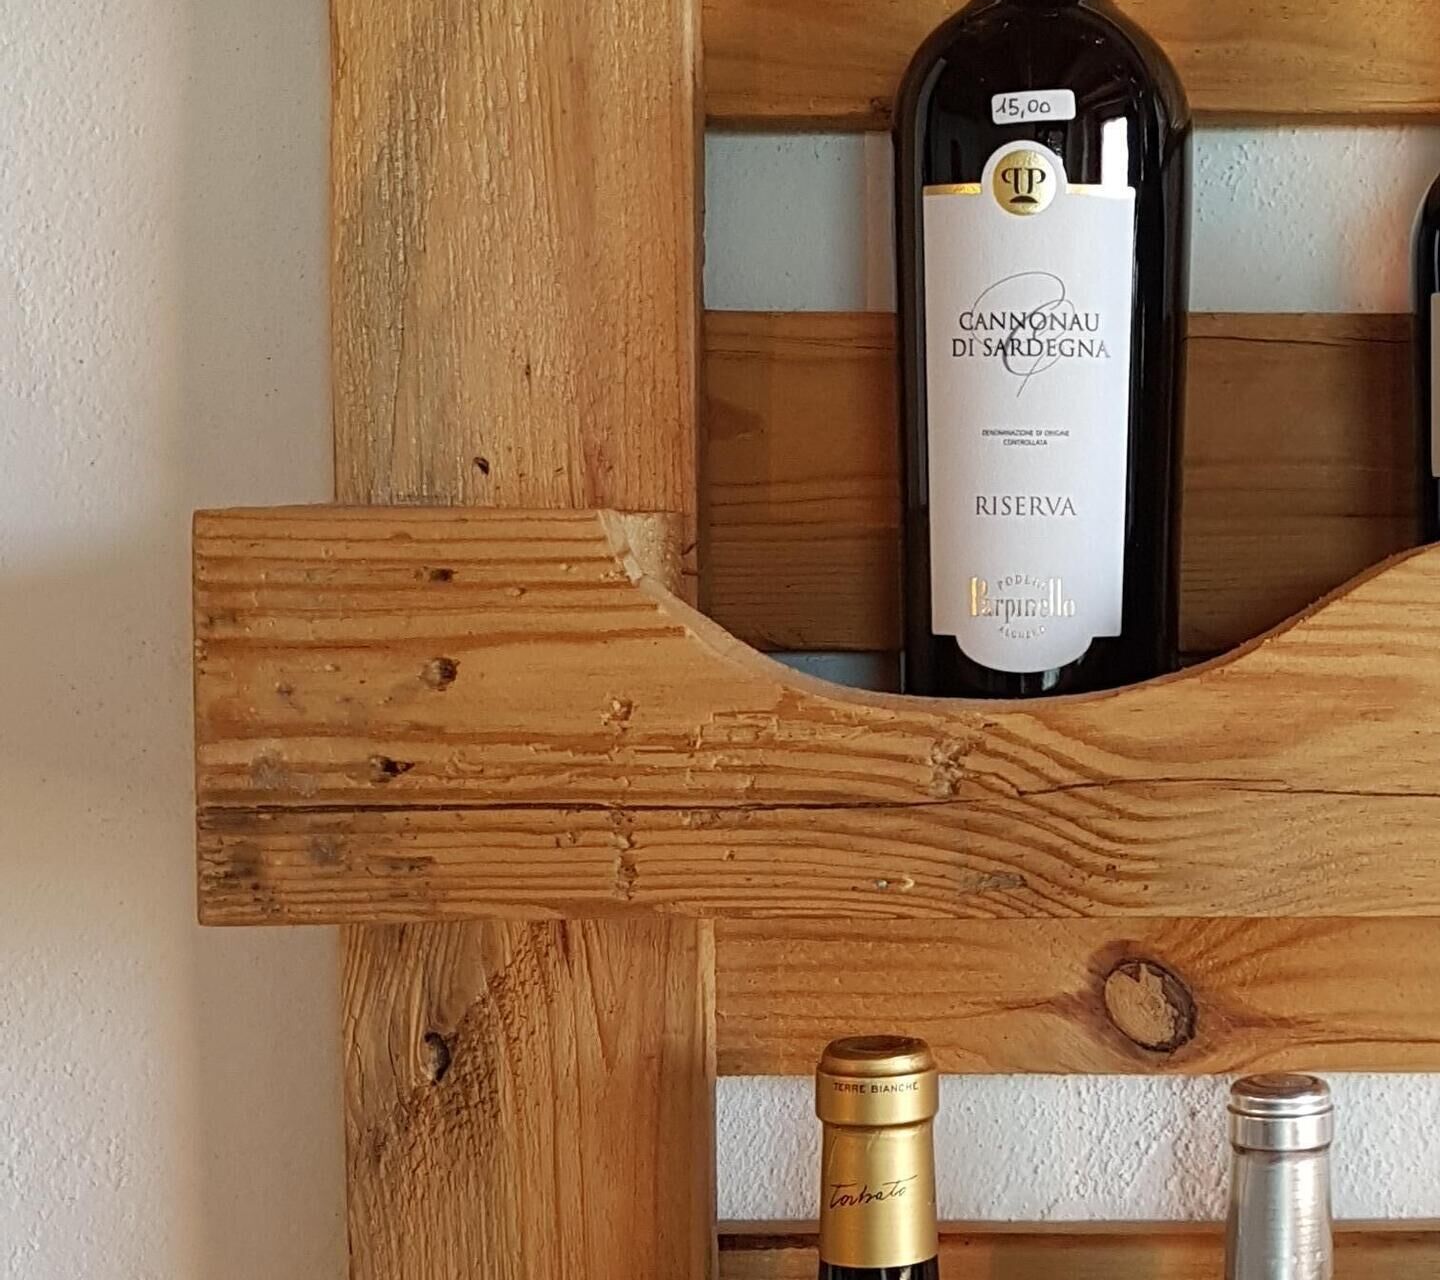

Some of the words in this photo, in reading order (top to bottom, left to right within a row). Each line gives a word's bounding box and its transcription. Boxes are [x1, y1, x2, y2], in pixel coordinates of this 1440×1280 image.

[995, 98, 1051, 118] 15,00
[958, 311, 1101, 332] CANNONAU
[951, 338, 975, 358] DI
[983, 338, 1112, 359] SARDEGNA
[975, 495, 1077, 516] RISERVA
[833, 1081, 867, 1094] TERRE
[870, 1081, 919, 1094] BIANCHE
